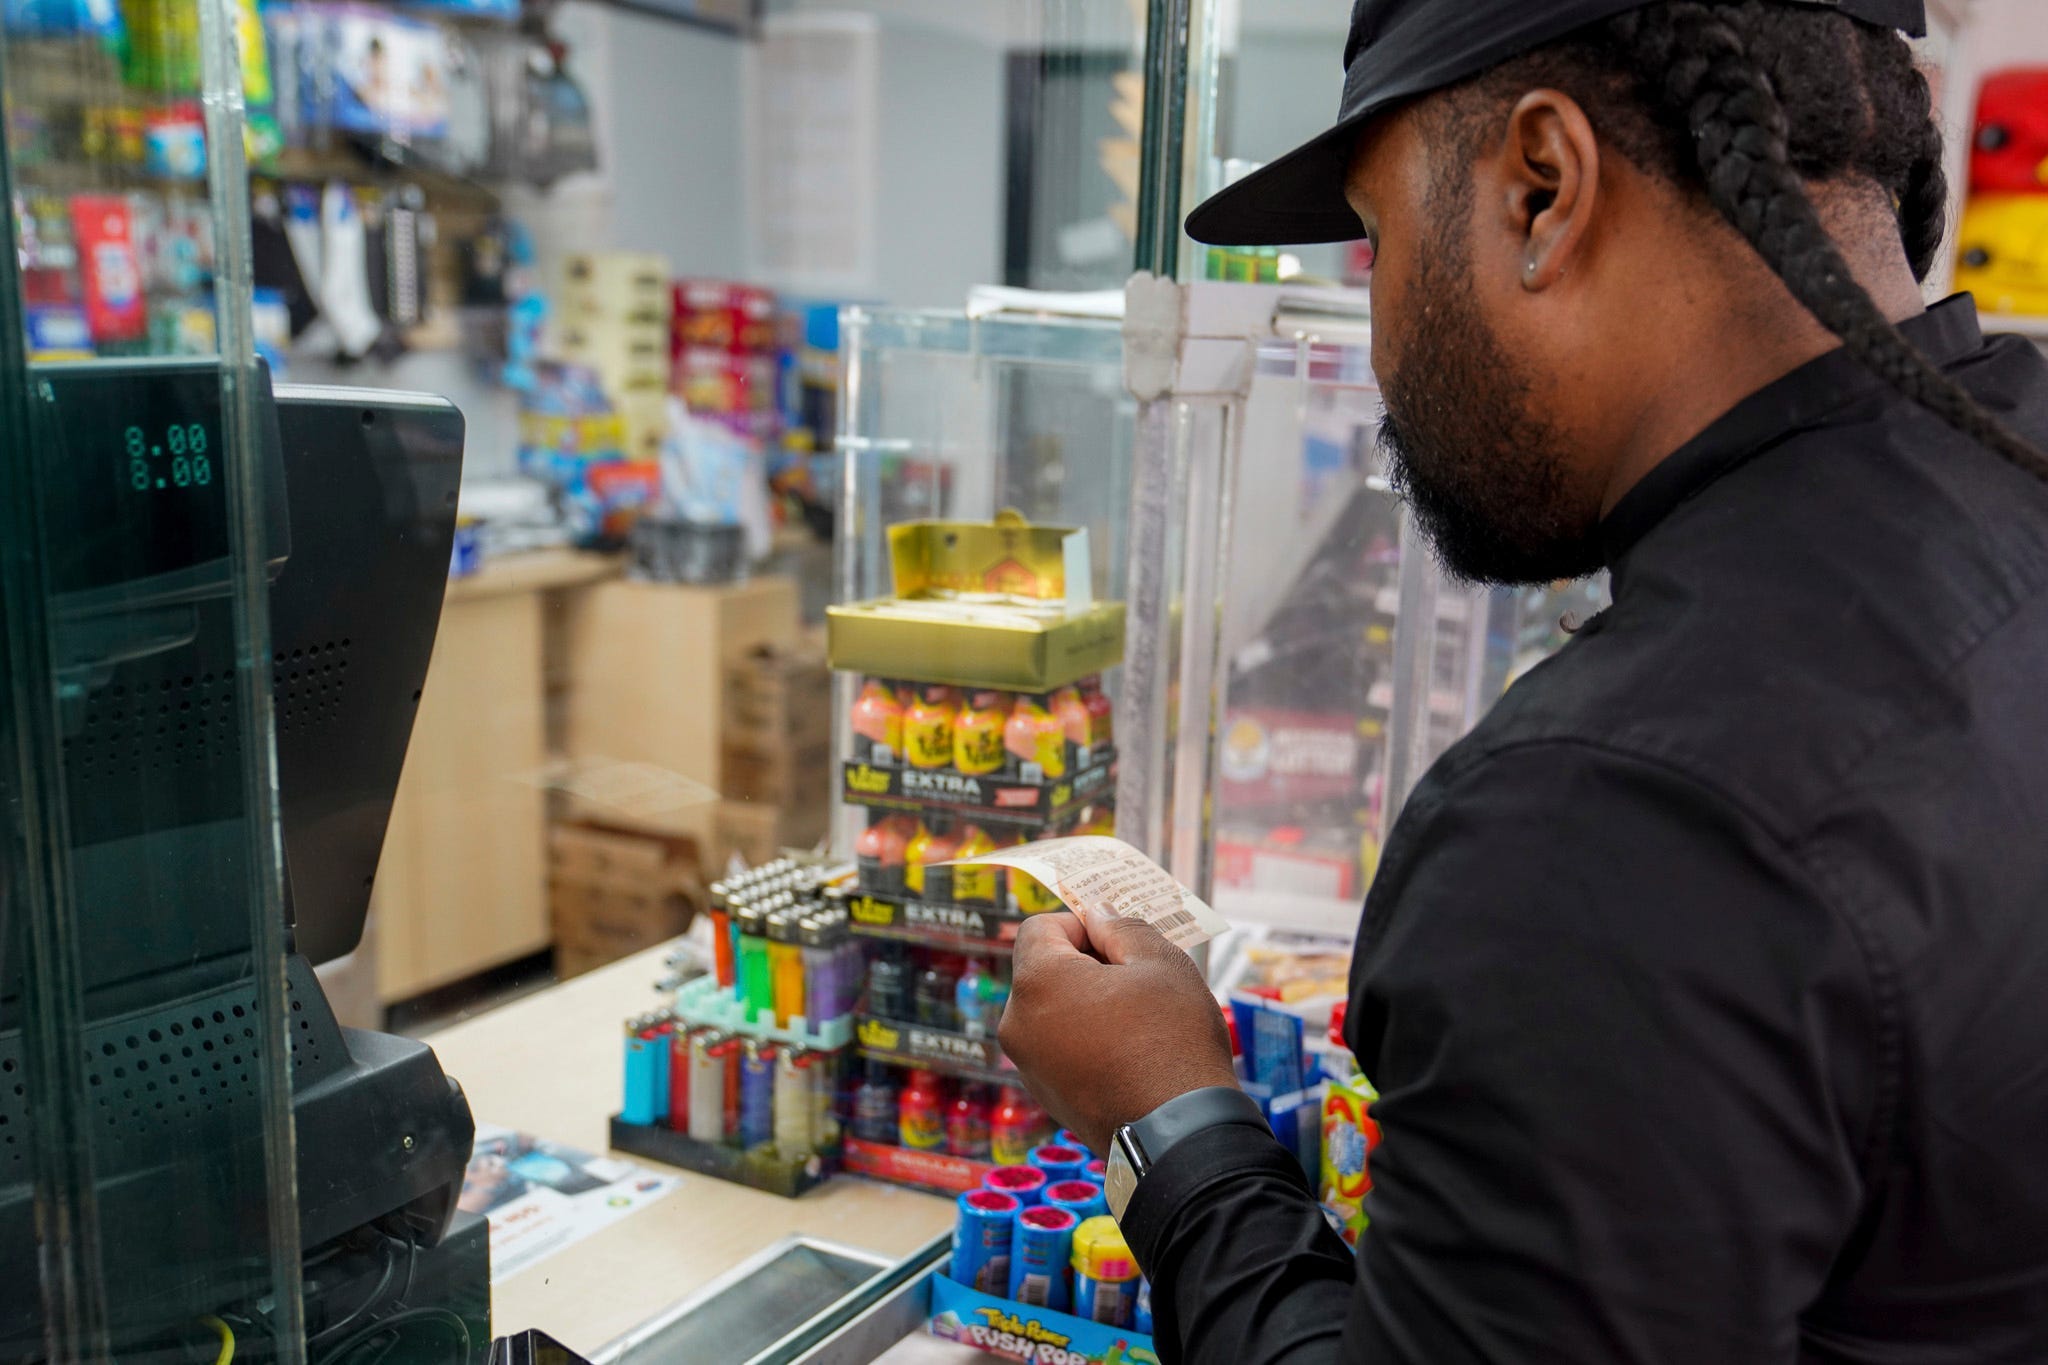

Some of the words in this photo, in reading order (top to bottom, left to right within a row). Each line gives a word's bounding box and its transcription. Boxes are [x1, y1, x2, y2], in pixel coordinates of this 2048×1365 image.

[125, 423, 208, 458] 8.00
[130, 455, 212, 491] 8.00
[901, 769, 982, 796] EXTRA
[904, 902, 985, 930] EXTRA
[908, 1030, 986, 1060] EXTRA
[968, 1323, 1036, 1358] PUSH
